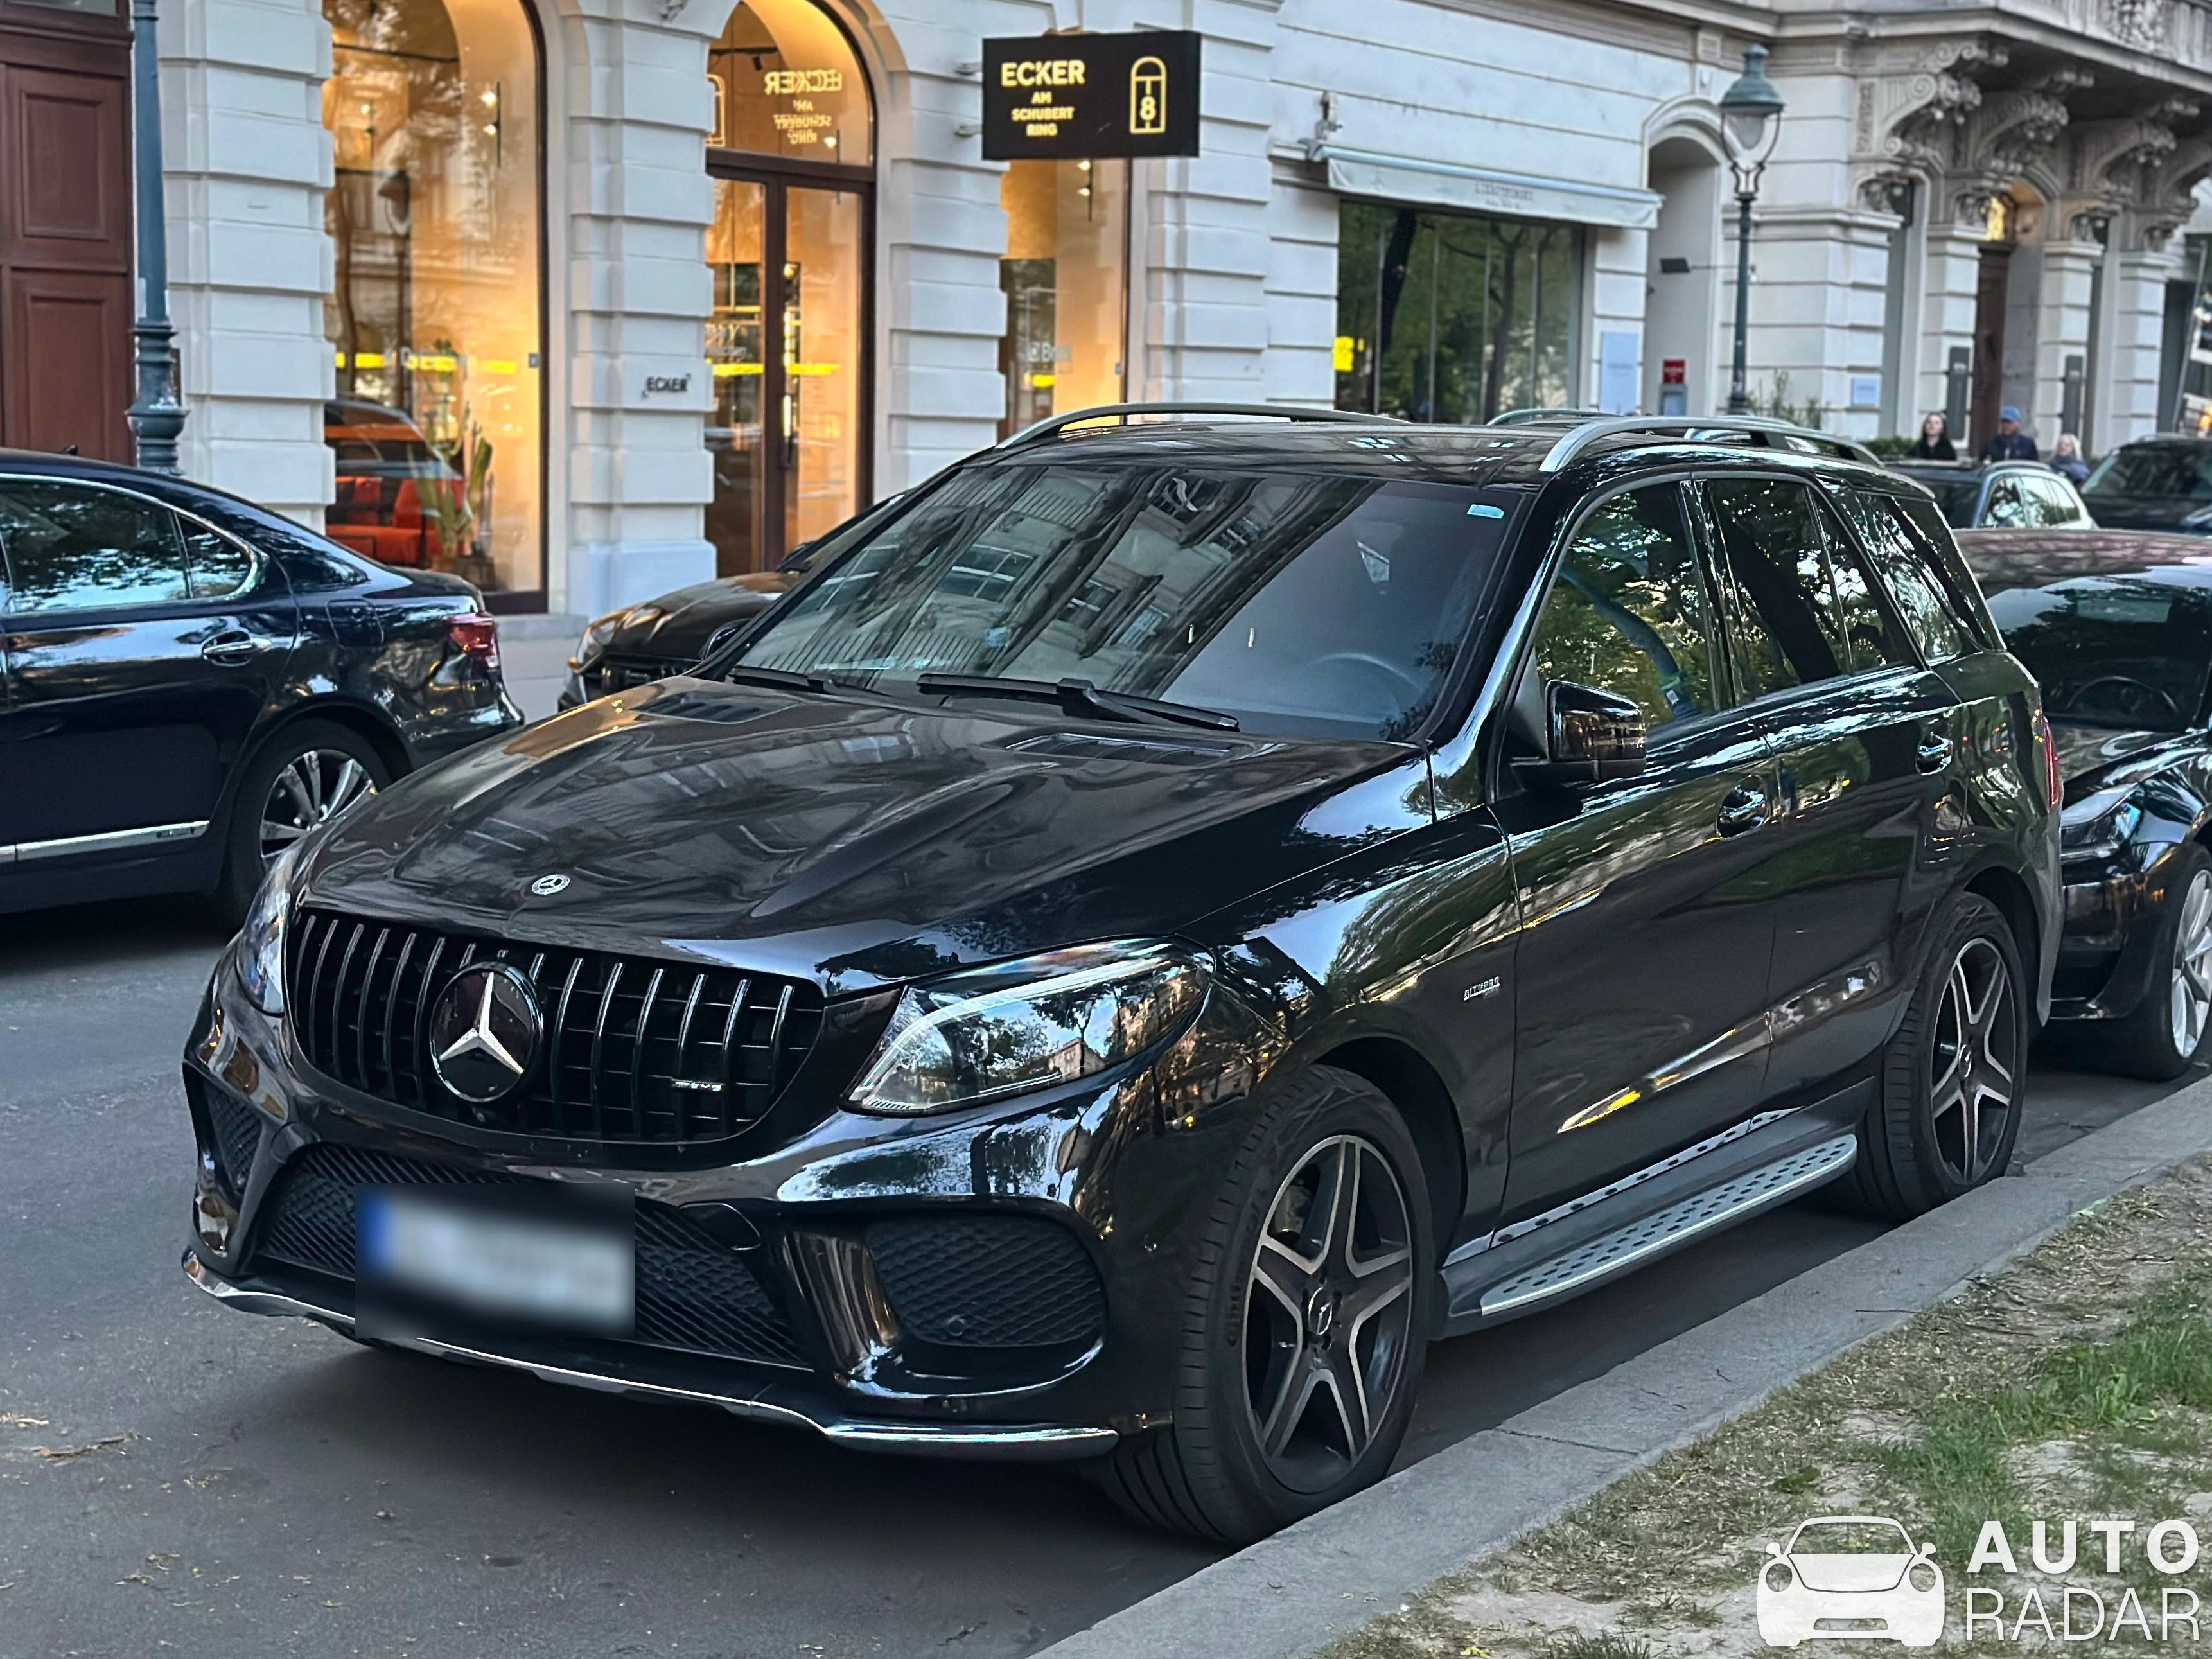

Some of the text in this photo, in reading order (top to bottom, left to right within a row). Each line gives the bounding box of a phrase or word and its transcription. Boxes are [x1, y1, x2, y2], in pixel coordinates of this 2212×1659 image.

[1001, 59, 1086, 87] ECKER
[1031, 91, 1052, 104] AM
[1011, 106, 1075, 121] SCHUBERT
[1026, 123, 1058, 136] RING
